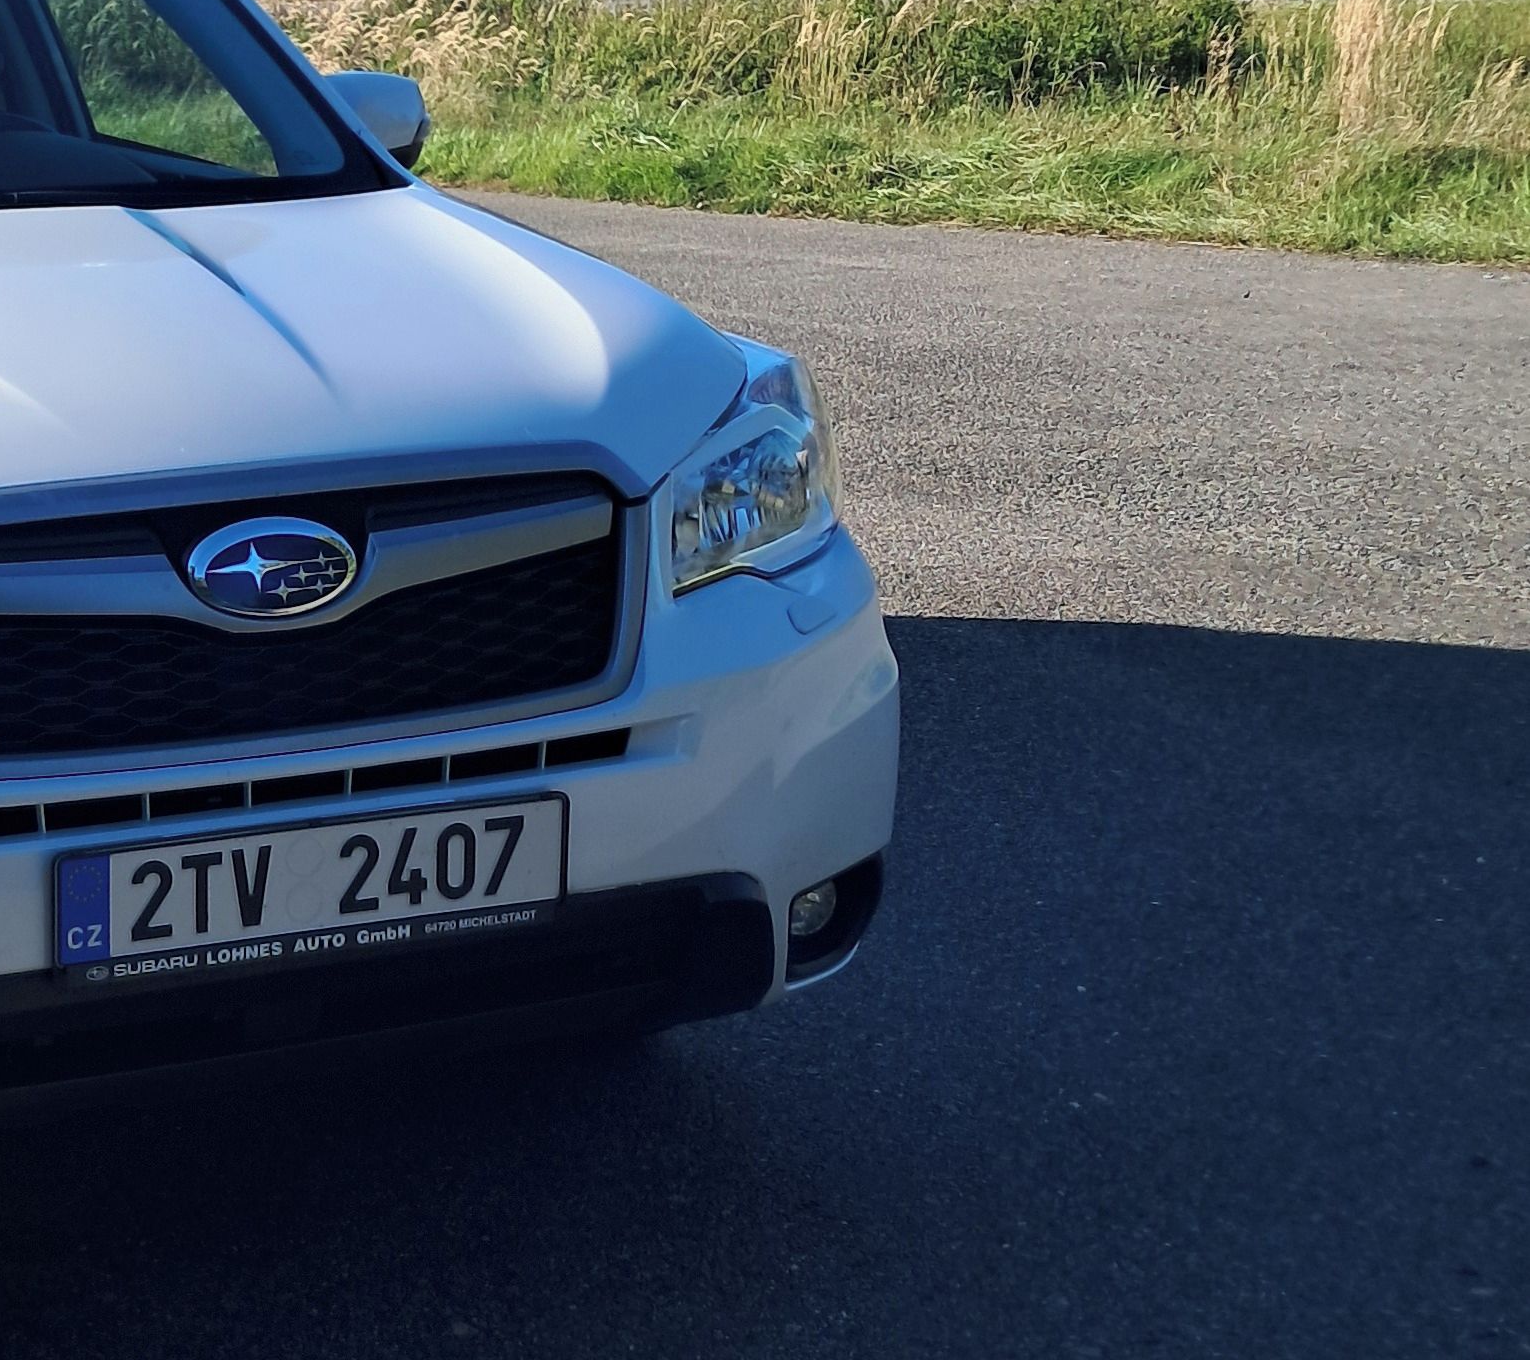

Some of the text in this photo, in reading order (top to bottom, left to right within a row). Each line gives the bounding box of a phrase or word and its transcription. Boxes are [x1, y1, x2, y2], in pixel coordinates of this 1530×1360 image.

[130, 814, 525, 942] 2TV 2407
[66, 923, 103, 950] CZ
[113, 909, 538, 977] SUBARU LOHNES AUTO GmbH 64720 MICHELSTADT
